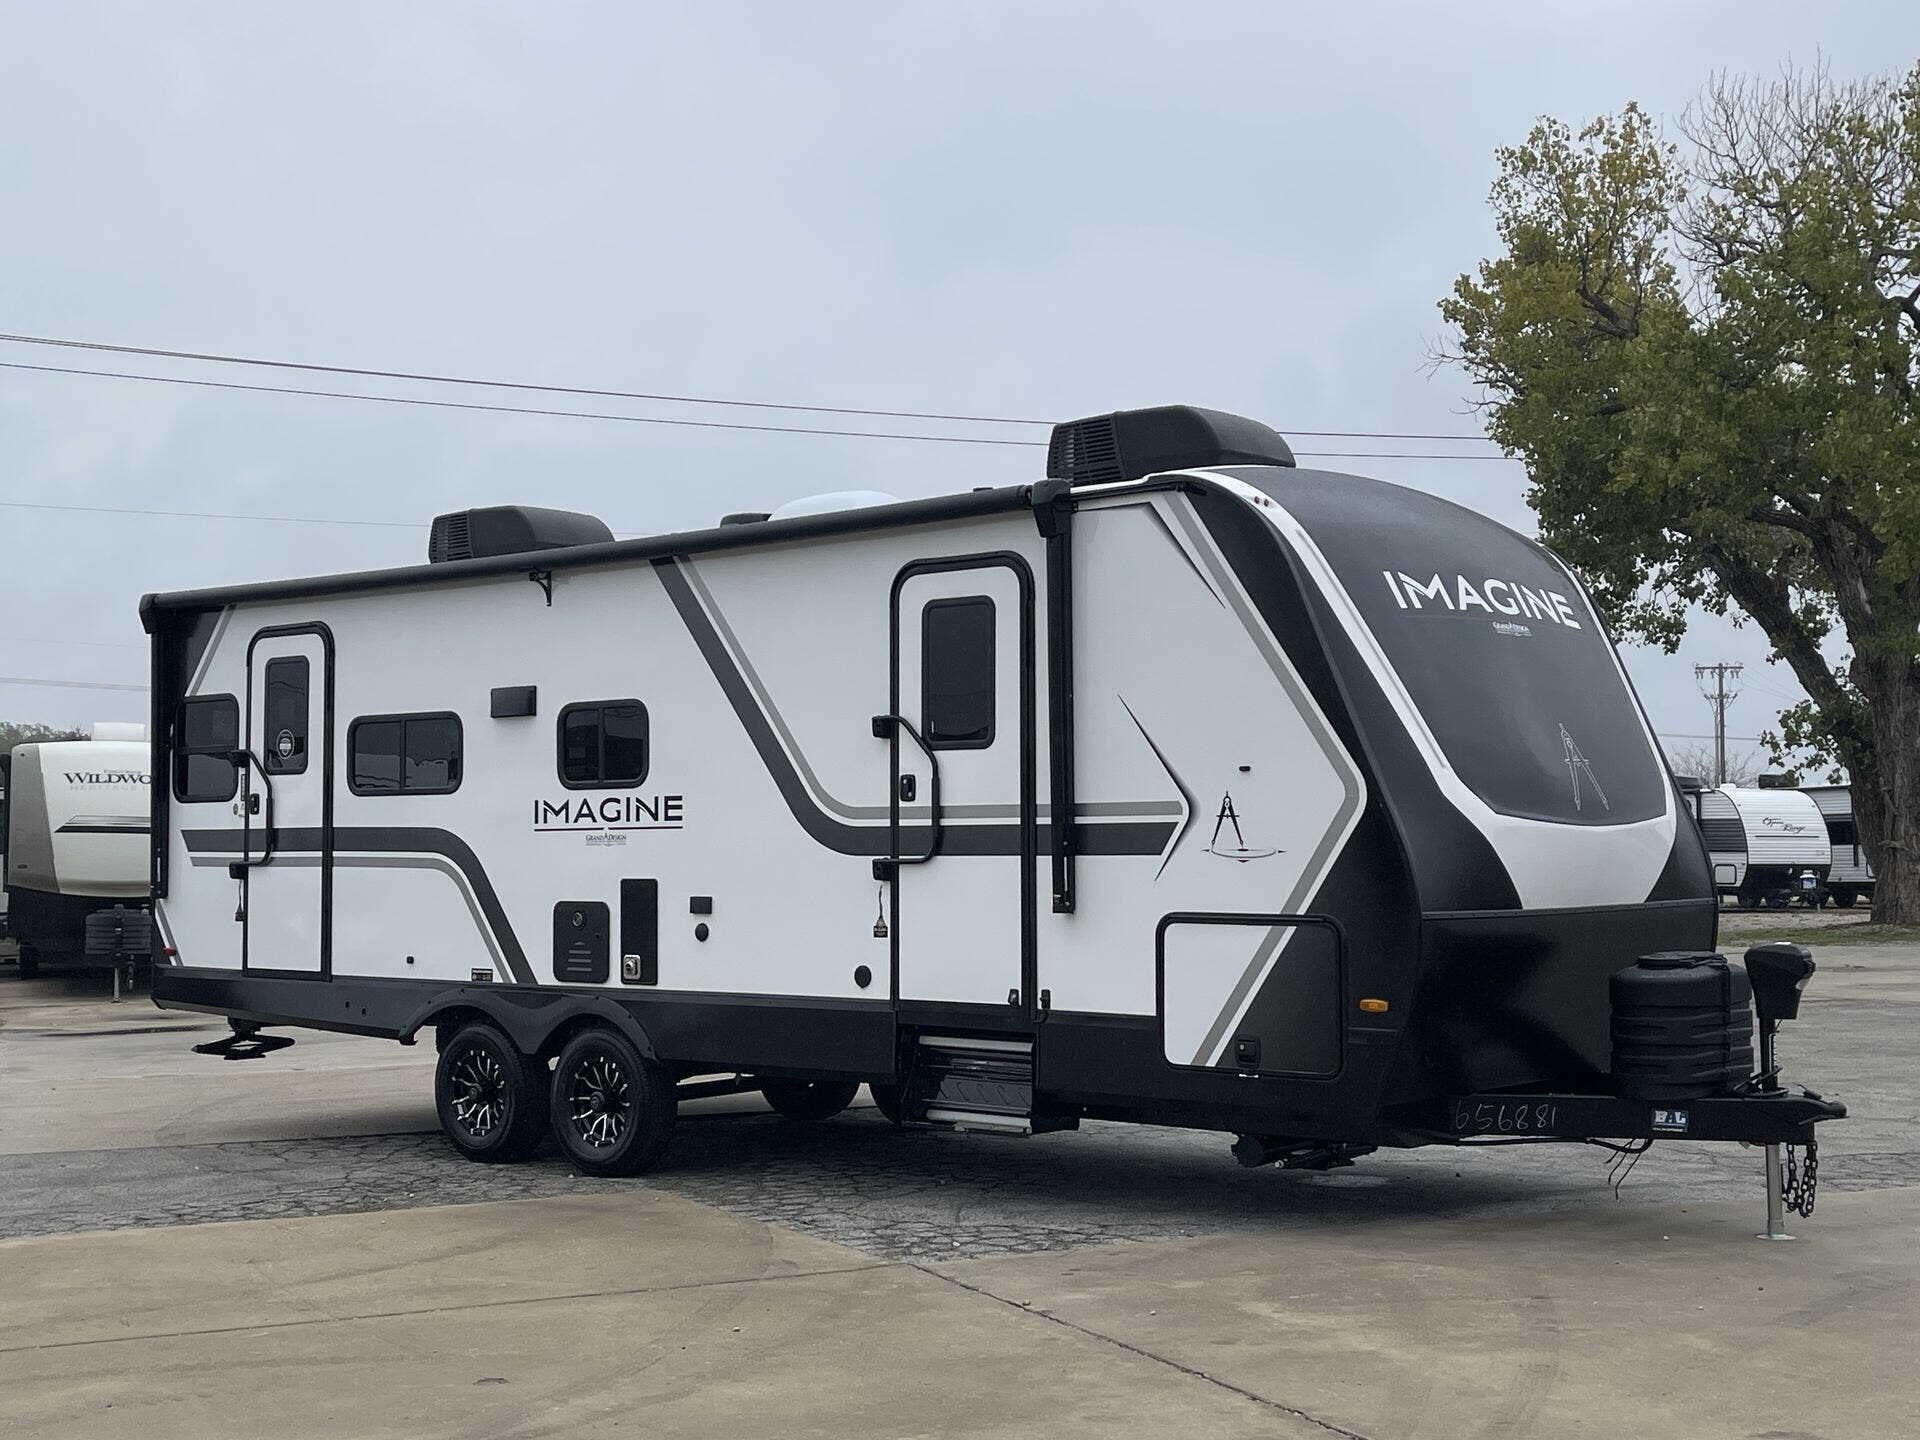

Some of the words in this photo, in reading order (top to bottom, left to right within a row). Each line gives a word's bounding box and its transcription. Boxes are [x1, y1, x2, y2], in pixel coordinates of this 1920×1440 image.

[1382, 570, 1582, 630] IMAGINE
[534, 795, 683, 824] IMAGINE
[1762, 817, 1784, 827] Open
[1455, 1100, 1556, 1132] 656881
